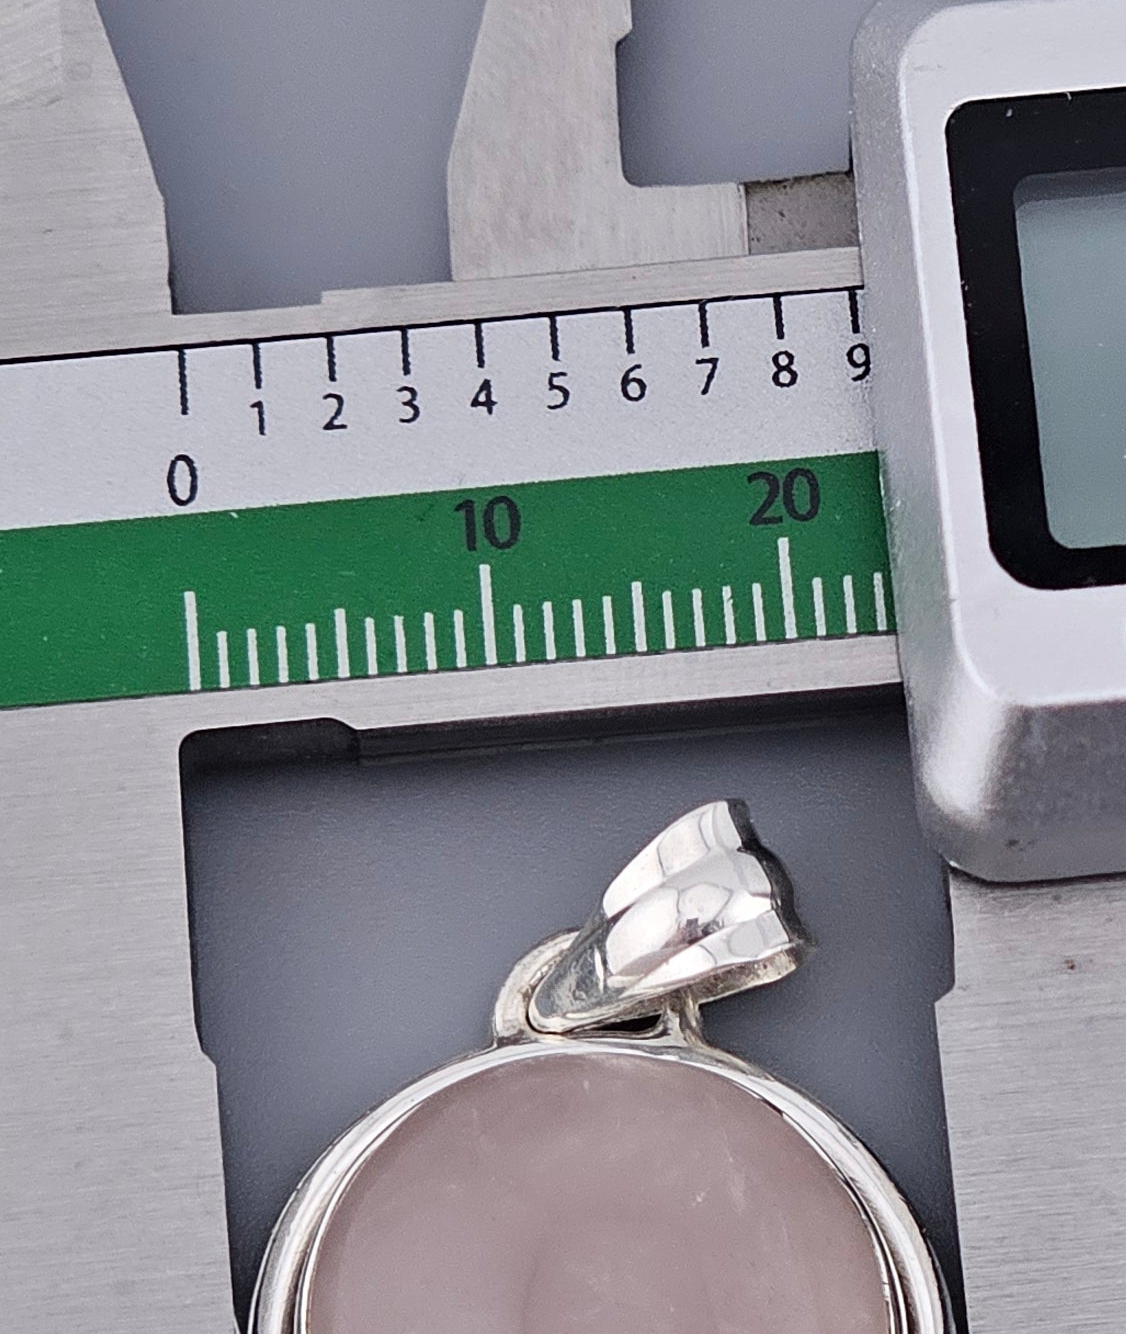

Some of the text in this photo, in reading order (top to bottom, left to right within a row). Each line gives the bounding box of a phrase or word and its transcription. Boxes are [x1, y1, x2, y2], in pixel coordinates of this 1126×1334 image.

[250, 342, 873, 436] 1 2 3 4 5 6 7 8 9
[167, 453, 199, 507] 0
[454, 466, 822, 552] 10 20
